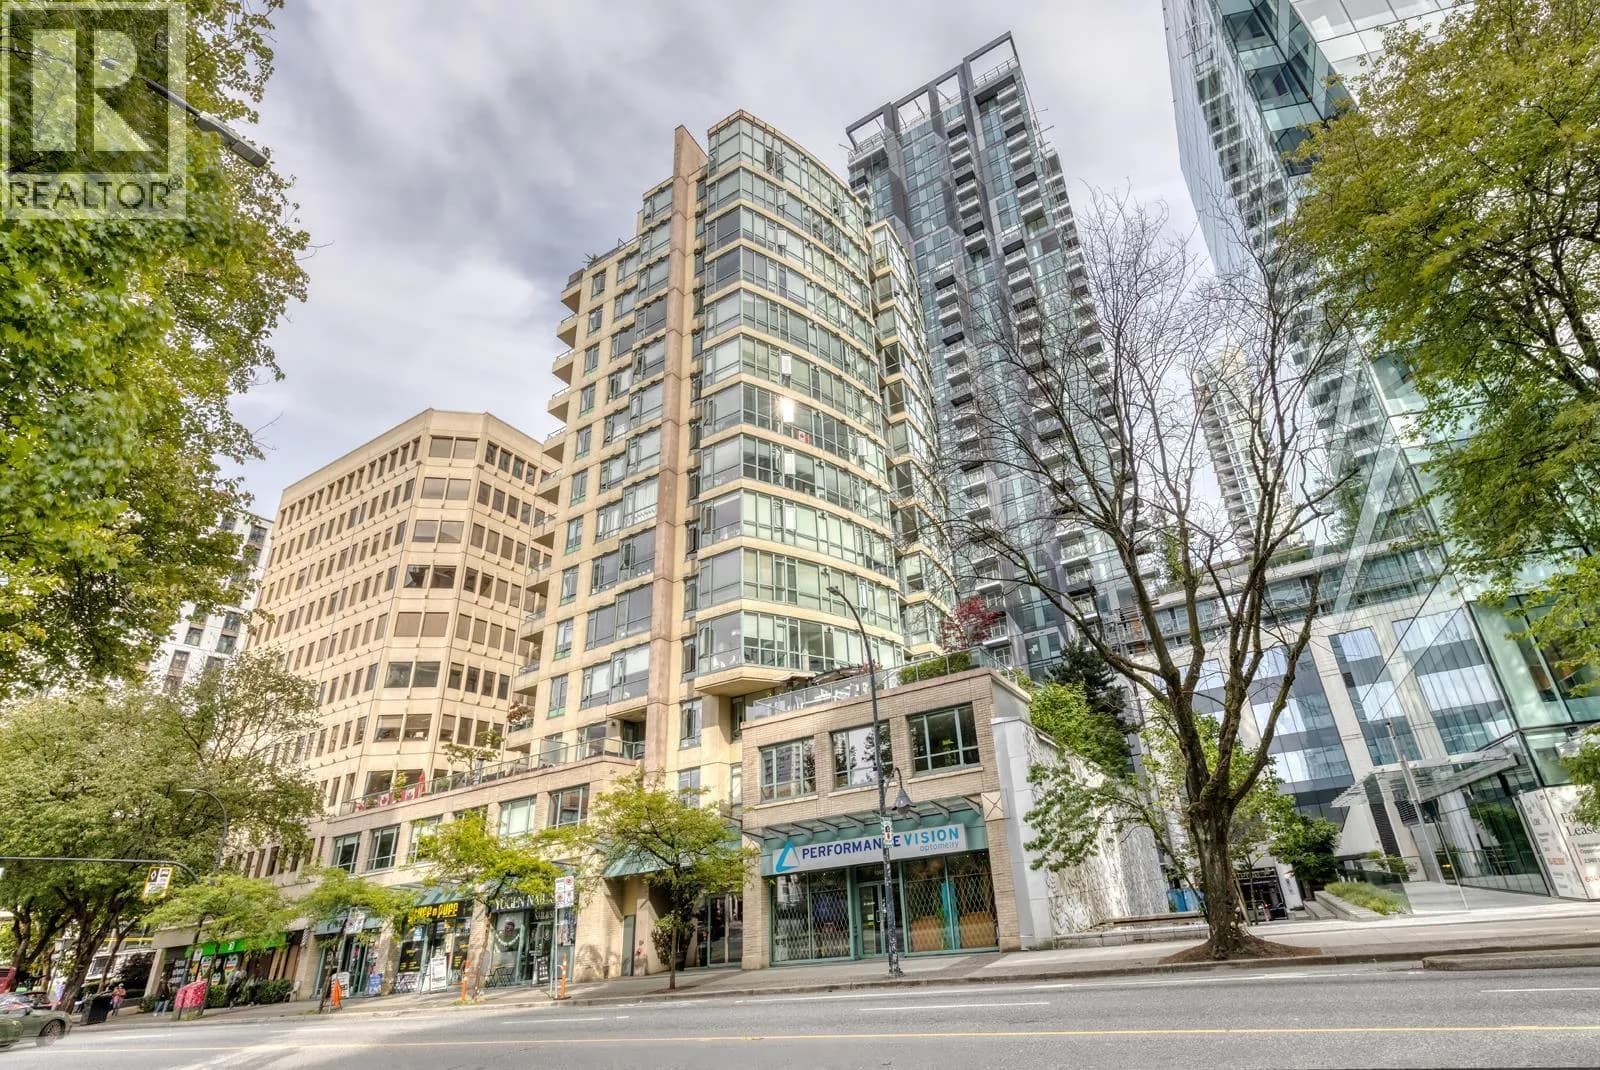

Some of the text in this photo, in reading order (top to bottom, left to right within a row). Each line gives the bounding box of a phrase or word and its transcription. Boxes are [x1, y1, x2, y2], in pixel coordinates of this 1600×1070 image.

[801, 835, 902, 860] PERFORMANE
[903, 827, 960, 846] VISION
[919, 840, 960, 852] optometry
